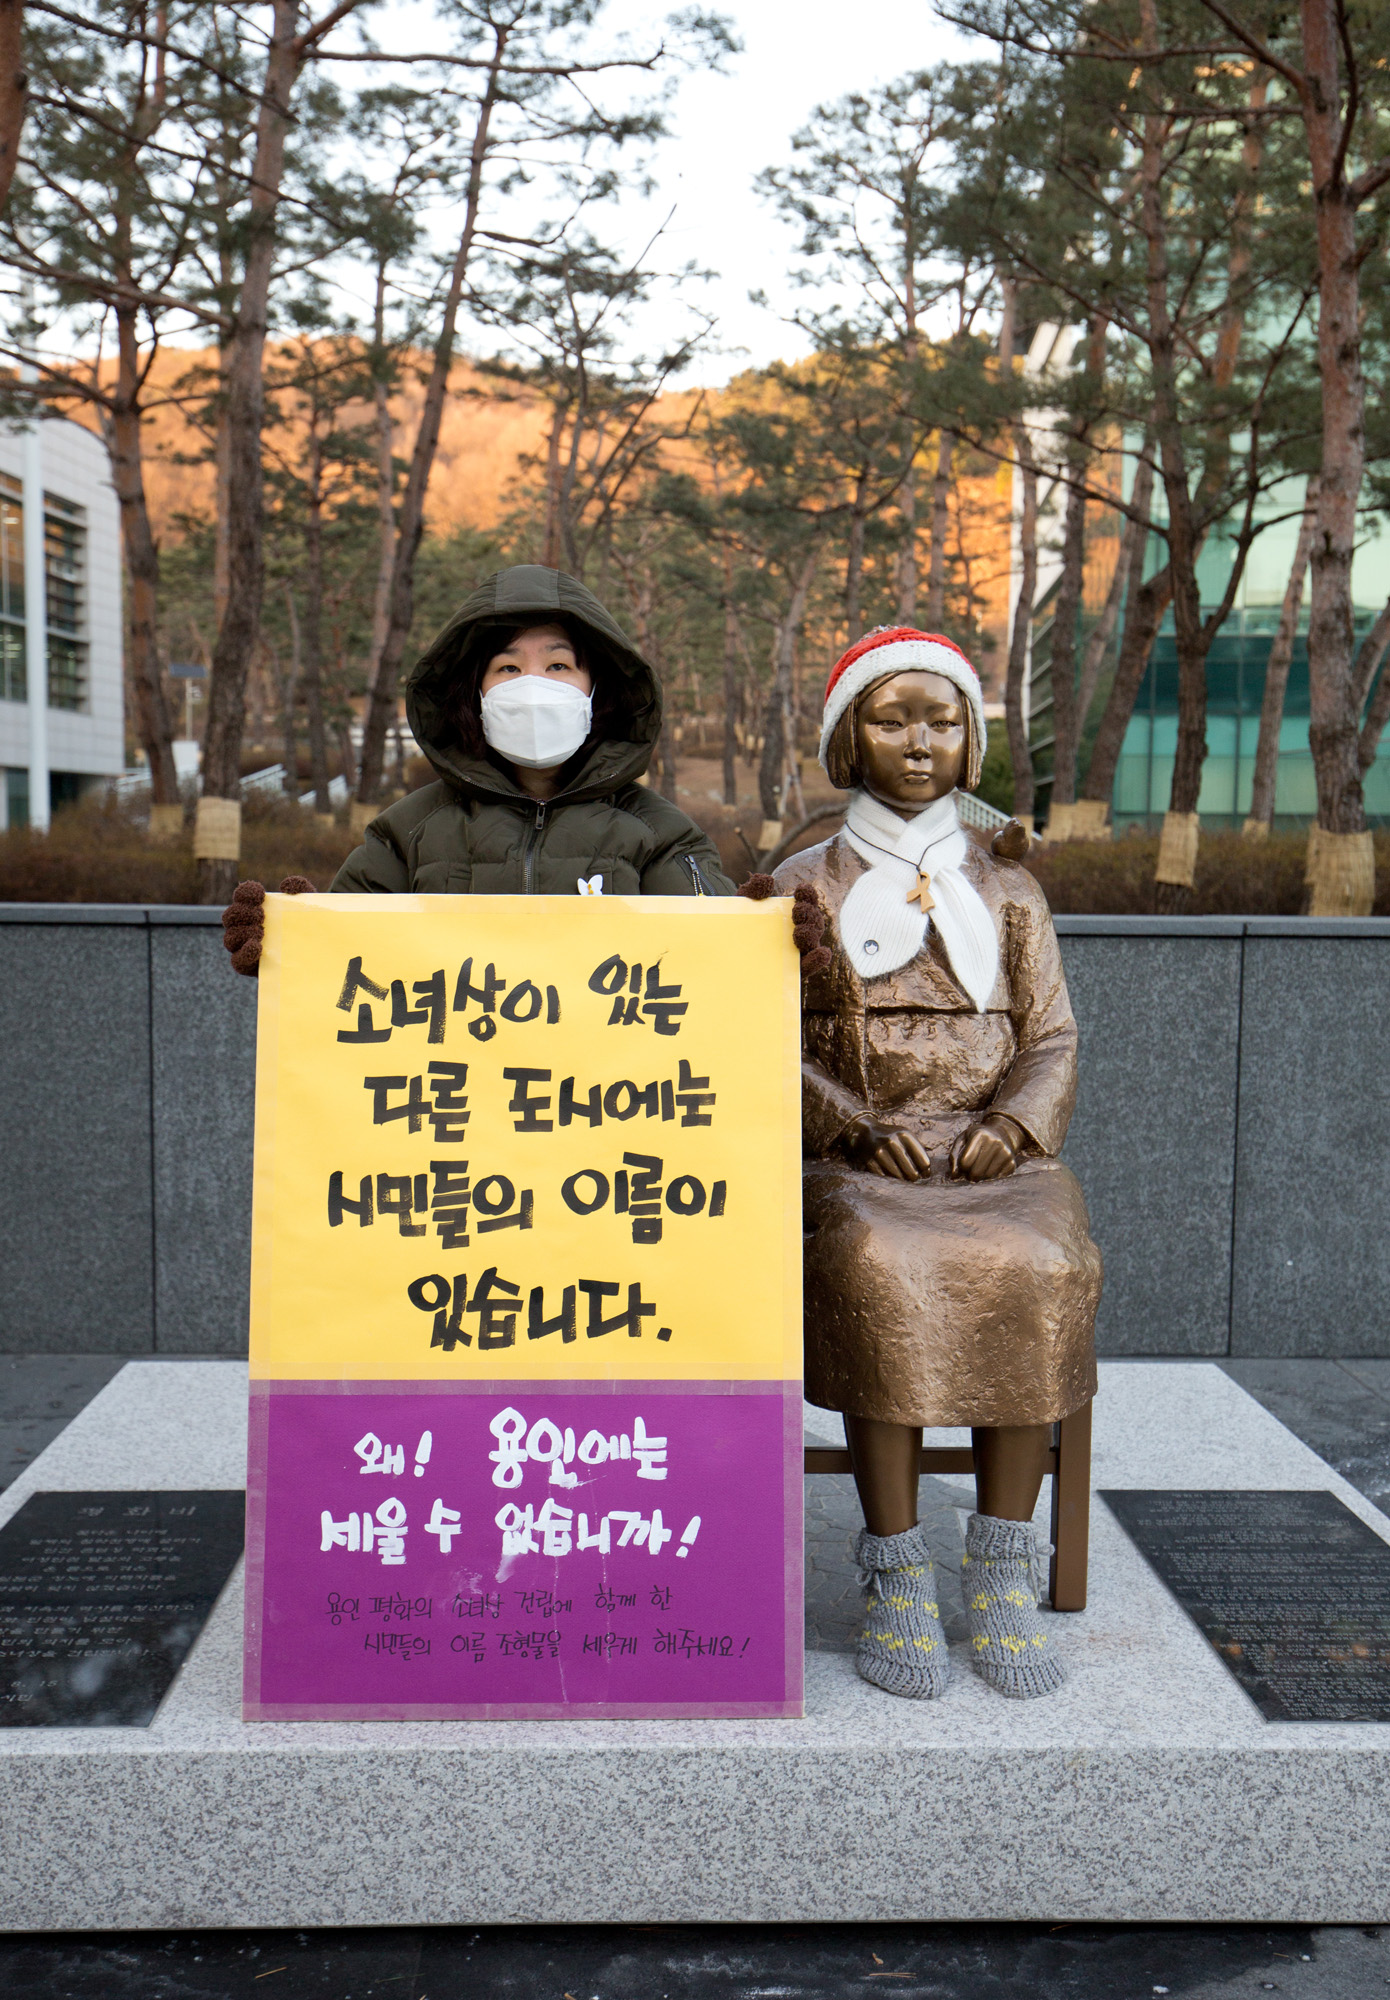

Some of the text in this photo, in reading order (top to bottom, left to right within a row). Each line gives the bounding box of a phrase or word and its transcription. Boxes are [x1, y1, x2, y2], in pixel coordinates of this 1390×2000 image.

[336, 951, 689, 1044] 소녀상이 있는
[364, 1059, 717, 1142] 다른 도시에는
[328, 1152, 727, 1249] 시민들의 이름이
[407, 1266, 673, 1352] 있습니다.
[353, 1406, 668, 1489] 왜! 용인에는
[320, 1497, 701, 1565] 세울 수 없습니까!
[325, 1583, 673, 1625] 용인 평화의 소녀상 건립에 함께 한
[364, 1628, 751, 1663] 시민들의 이름 조형물을 세우게 해주세요!
